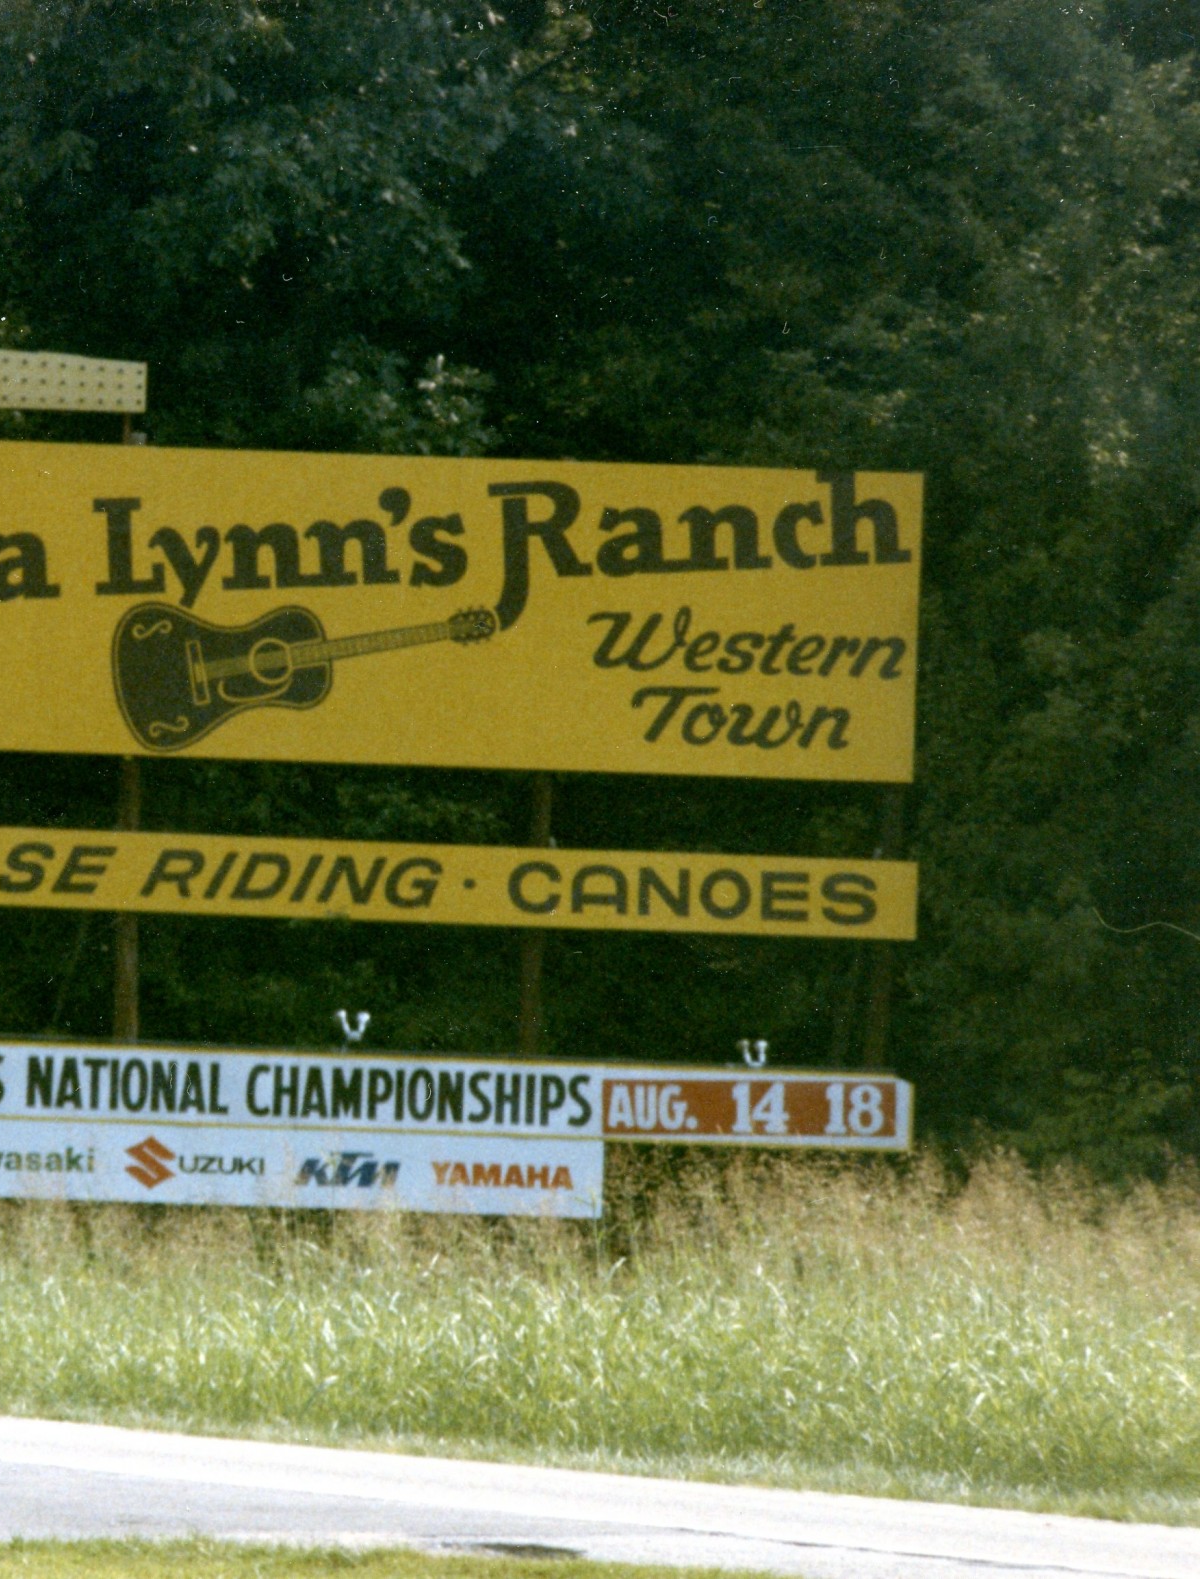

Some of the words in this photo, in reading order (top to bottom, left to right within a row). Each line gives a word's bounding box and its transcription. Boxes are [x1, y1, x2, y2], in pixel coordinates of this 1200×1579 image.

[92, 486, 469, 609] Lynn's
[487, 470, 913, 632] Ranch
[586, 605, 908, 681] Western
[630, 684, 851, 751] Town
[140, 848, 445, 909] RIDING
[507, 860, 879, 926] CANOES
[25, 1055, 230, 1116] NATIONAL
[245, 1064, 594, 1127] CHAMPIONSHIPS
[607, 1083, 698, 1132] AUG.
[730, 1081, 791, 1135] 14
[823, 1082, 885, 1137] 18
[294, 1151, 402, 1189] KTM
[431, 1160, 575, 1191] YAMAHA
